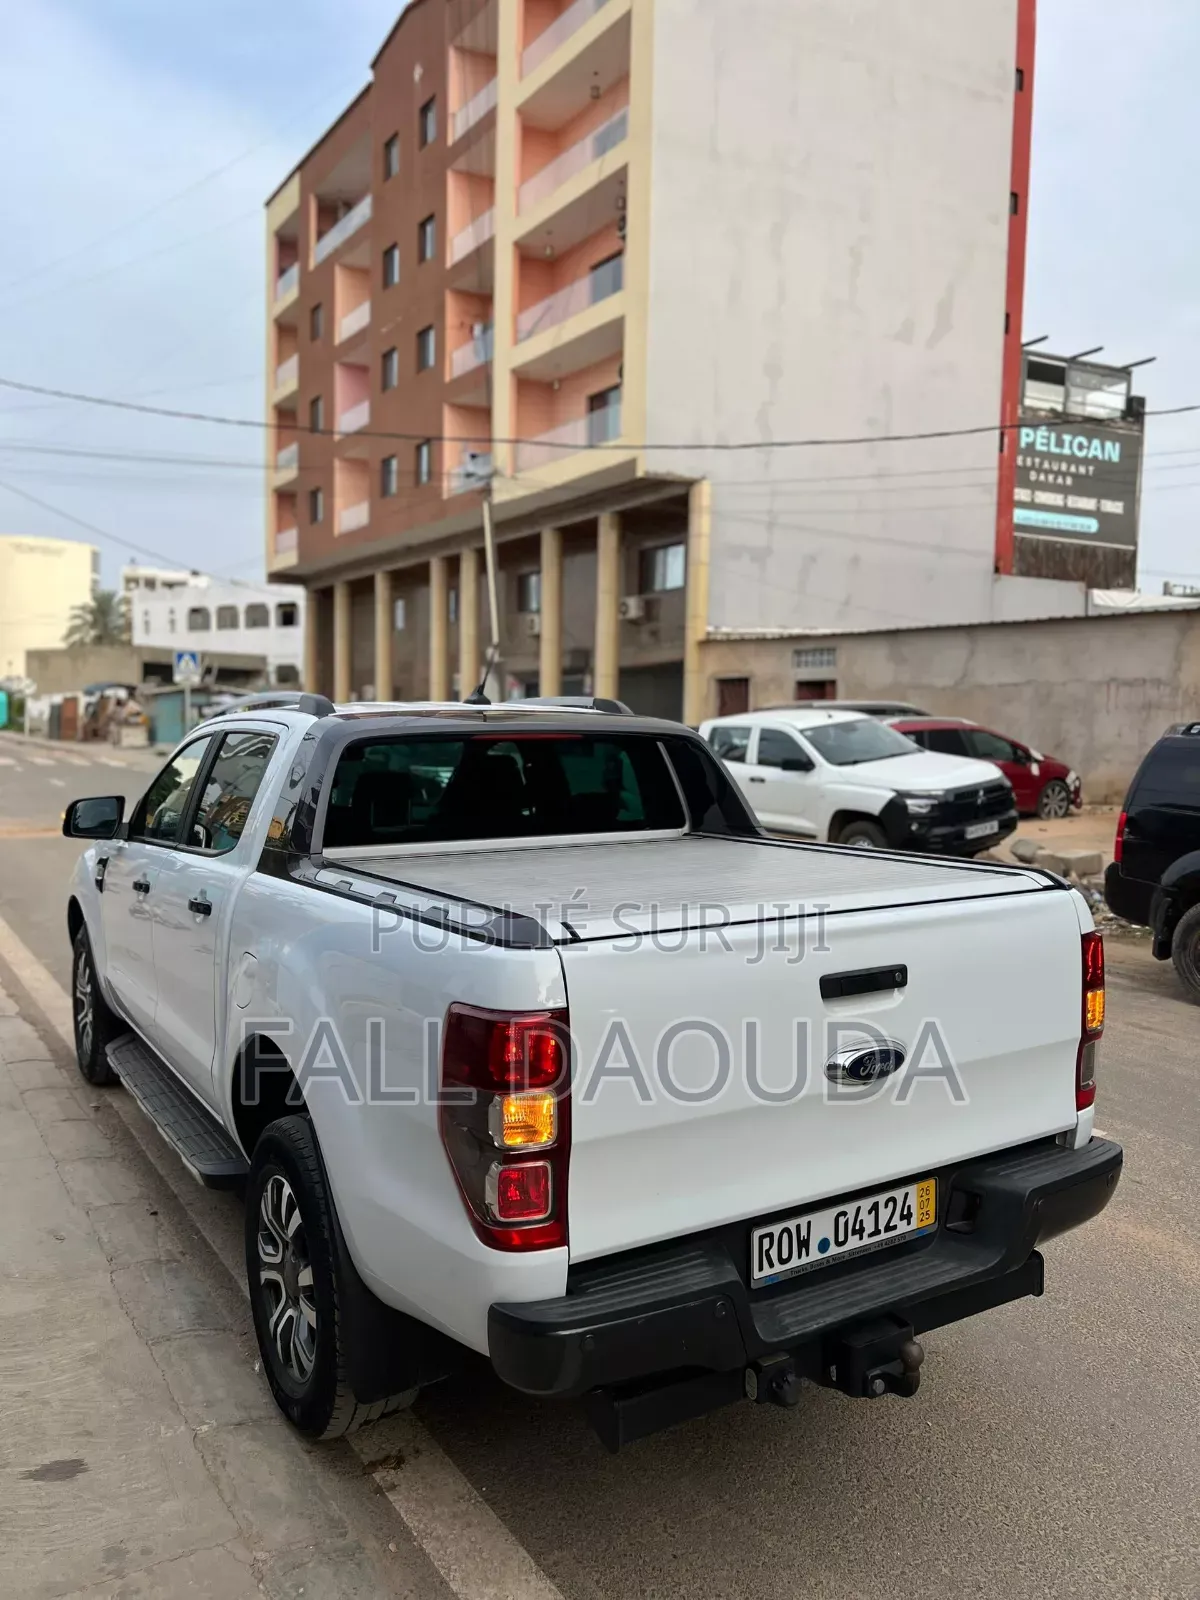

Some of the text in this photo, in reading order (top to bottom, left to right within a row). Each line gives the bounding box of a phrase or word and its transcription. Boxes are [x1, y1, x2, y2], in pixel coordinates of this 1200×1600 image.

[1020, 426, 1120, 462] PÉLICAN
[1016, 455, 1095, 476] ESTAURANT
[1029, 471, 1073, 486] DAKAR
[860, 1055, 894, 1076] Ford
[919, 1185, 931, 1198] 26
[919, 1198, 931, 1210] 07
[919, 1211, 931, 1222] 25
[758, 1192, 913, 1273] ROW 04124
